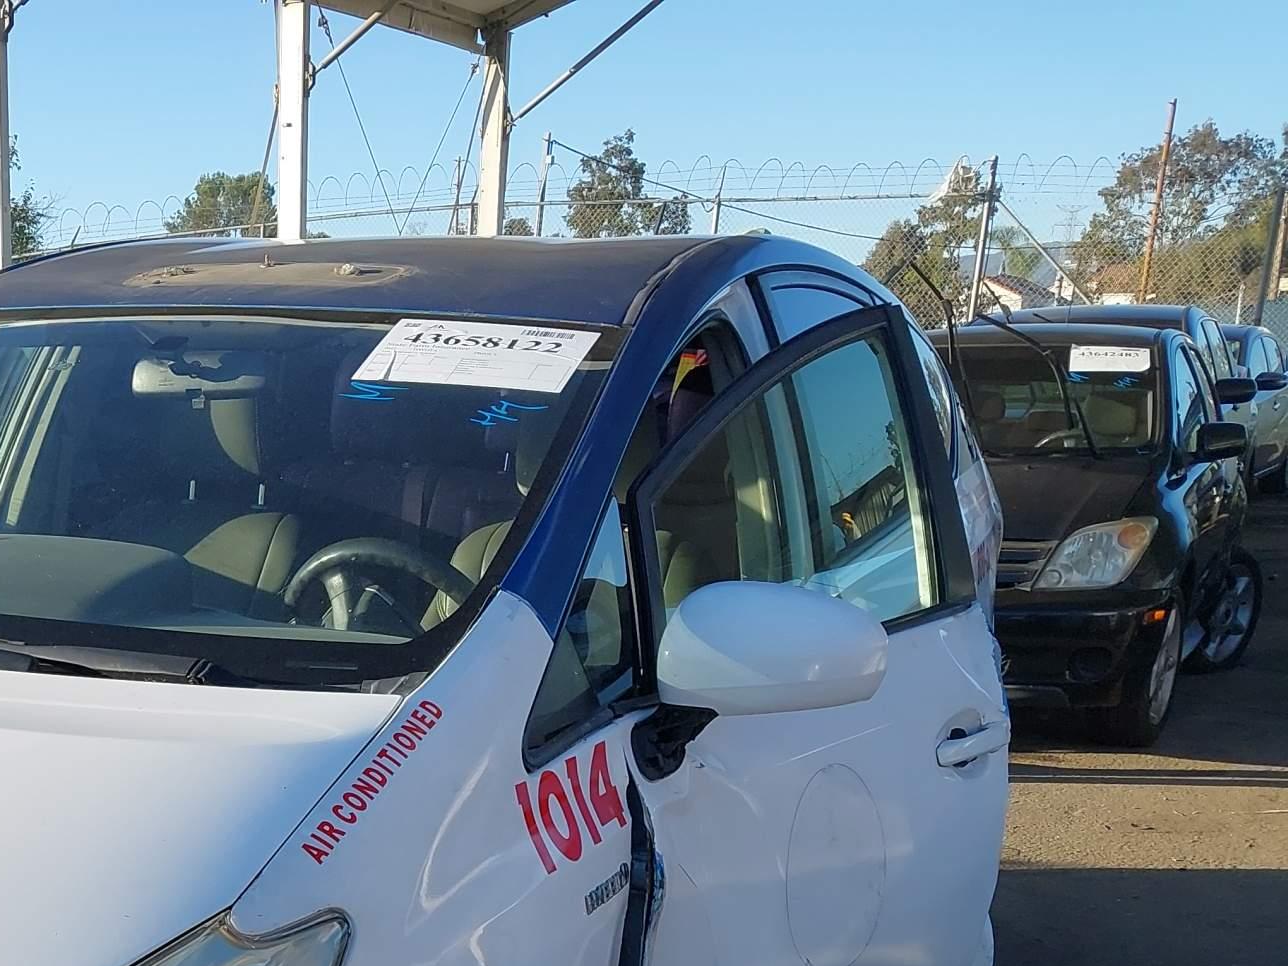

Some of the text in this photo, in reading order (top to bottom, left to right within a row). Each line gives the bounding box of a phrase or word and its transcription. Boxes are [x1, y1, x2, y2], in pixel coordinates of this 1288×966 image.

[403, 332, 562, 354] 43658122
[301, 700, 443, 865] AIR CONDITIONED
[514, 740, 628, 875] 1014
